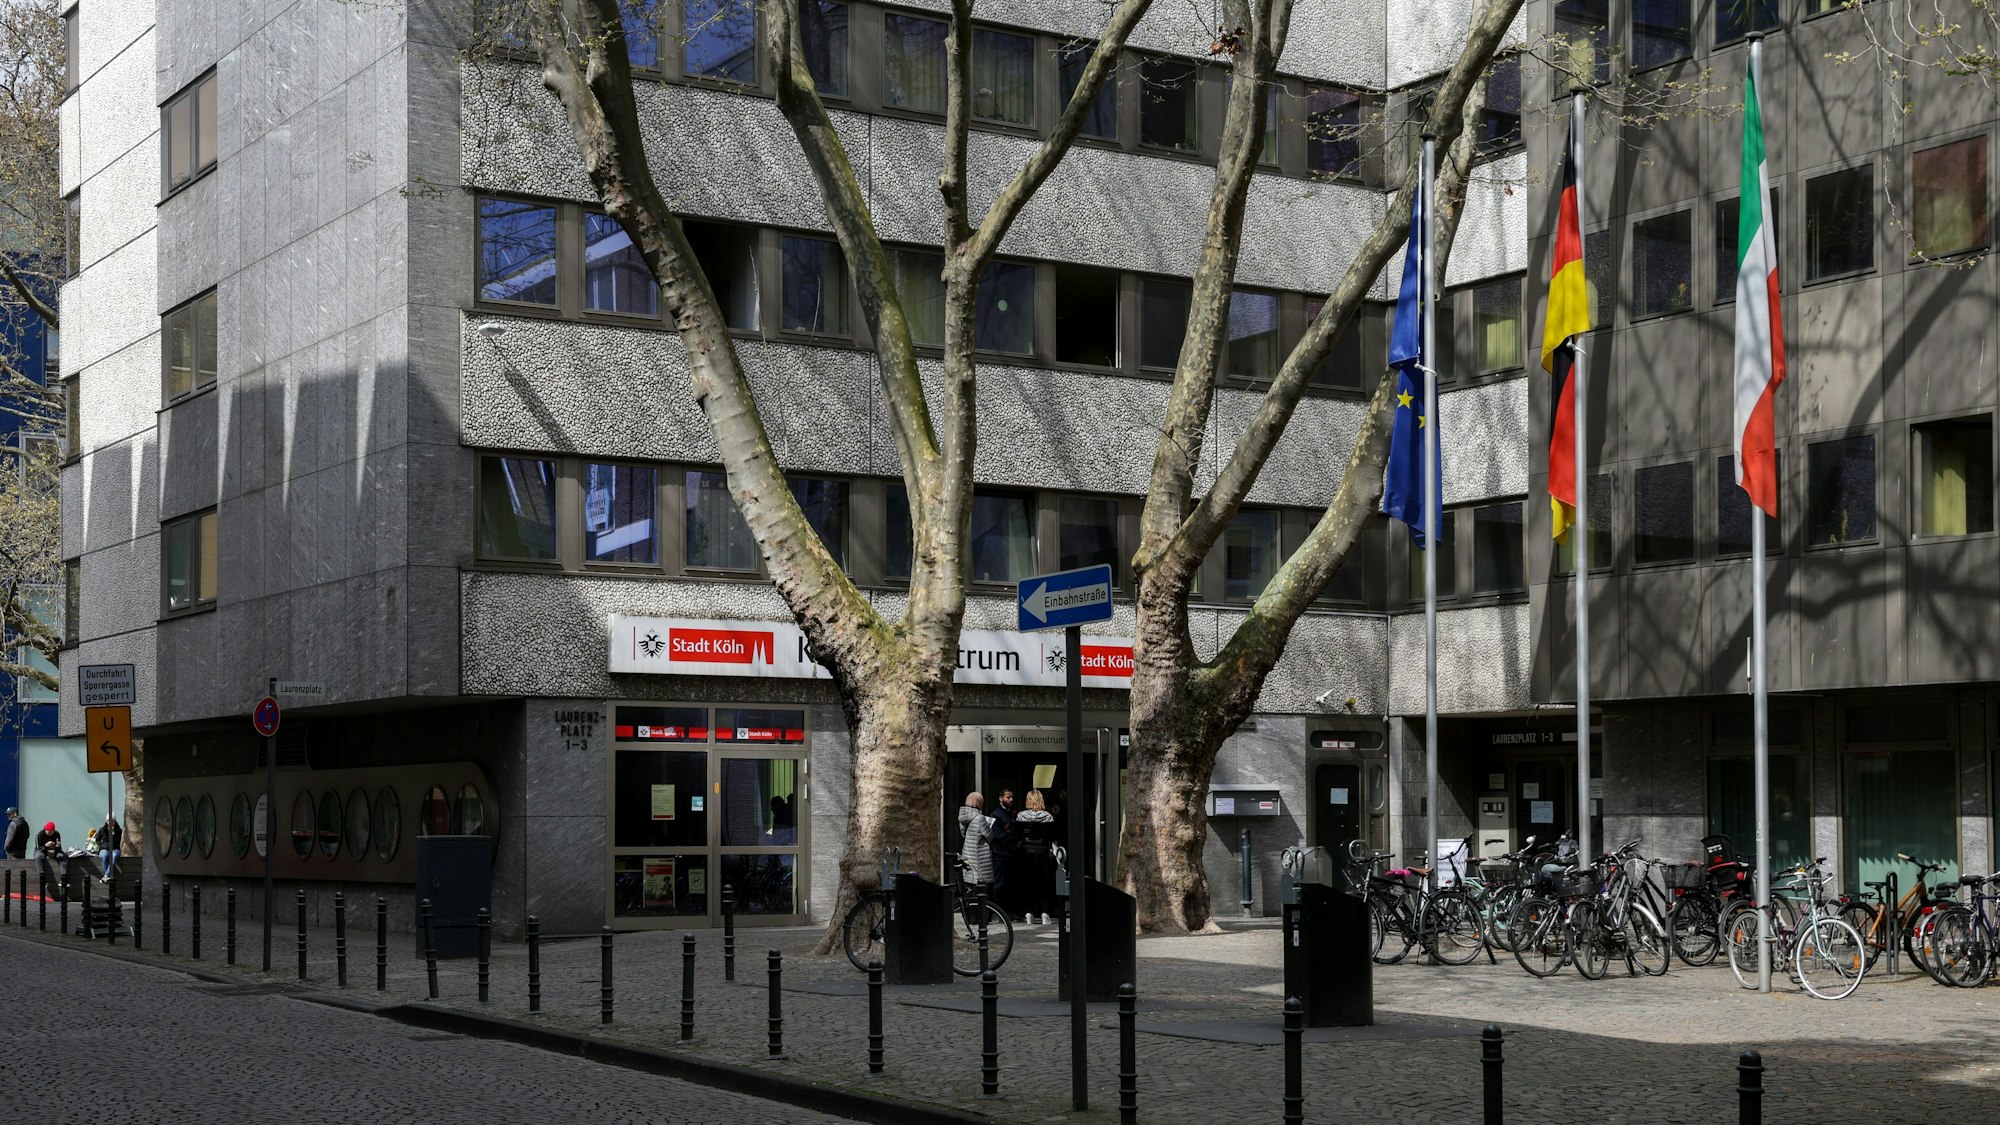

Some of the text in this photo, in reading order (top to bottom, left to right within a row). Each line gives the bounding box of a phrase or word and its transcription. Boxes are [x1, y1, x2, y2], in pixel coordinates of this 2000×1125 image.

[1044, 588, 1106, 608] Einbahnstraße
[672, 638, 744, 654] Stadt Köln
[1080, 653, 1134, 669] tadt Köln
[86, 669, 126, 679] Durchfahrt
[83, 681, 130, 692] Sporergasse
[280, 684, 322, 695] Laurenzplatz
[85, 691, 130, 703] gesperrt
[555, 710, 607, 723] LAURENZ-
[103, 716, 114, 730] U
[560, 725, 593, 737] PLATZ
[1000, 735, 1066, 744] Kundenzentrum
[1492, 732, 1537, 745] LAURENZPLATZ
